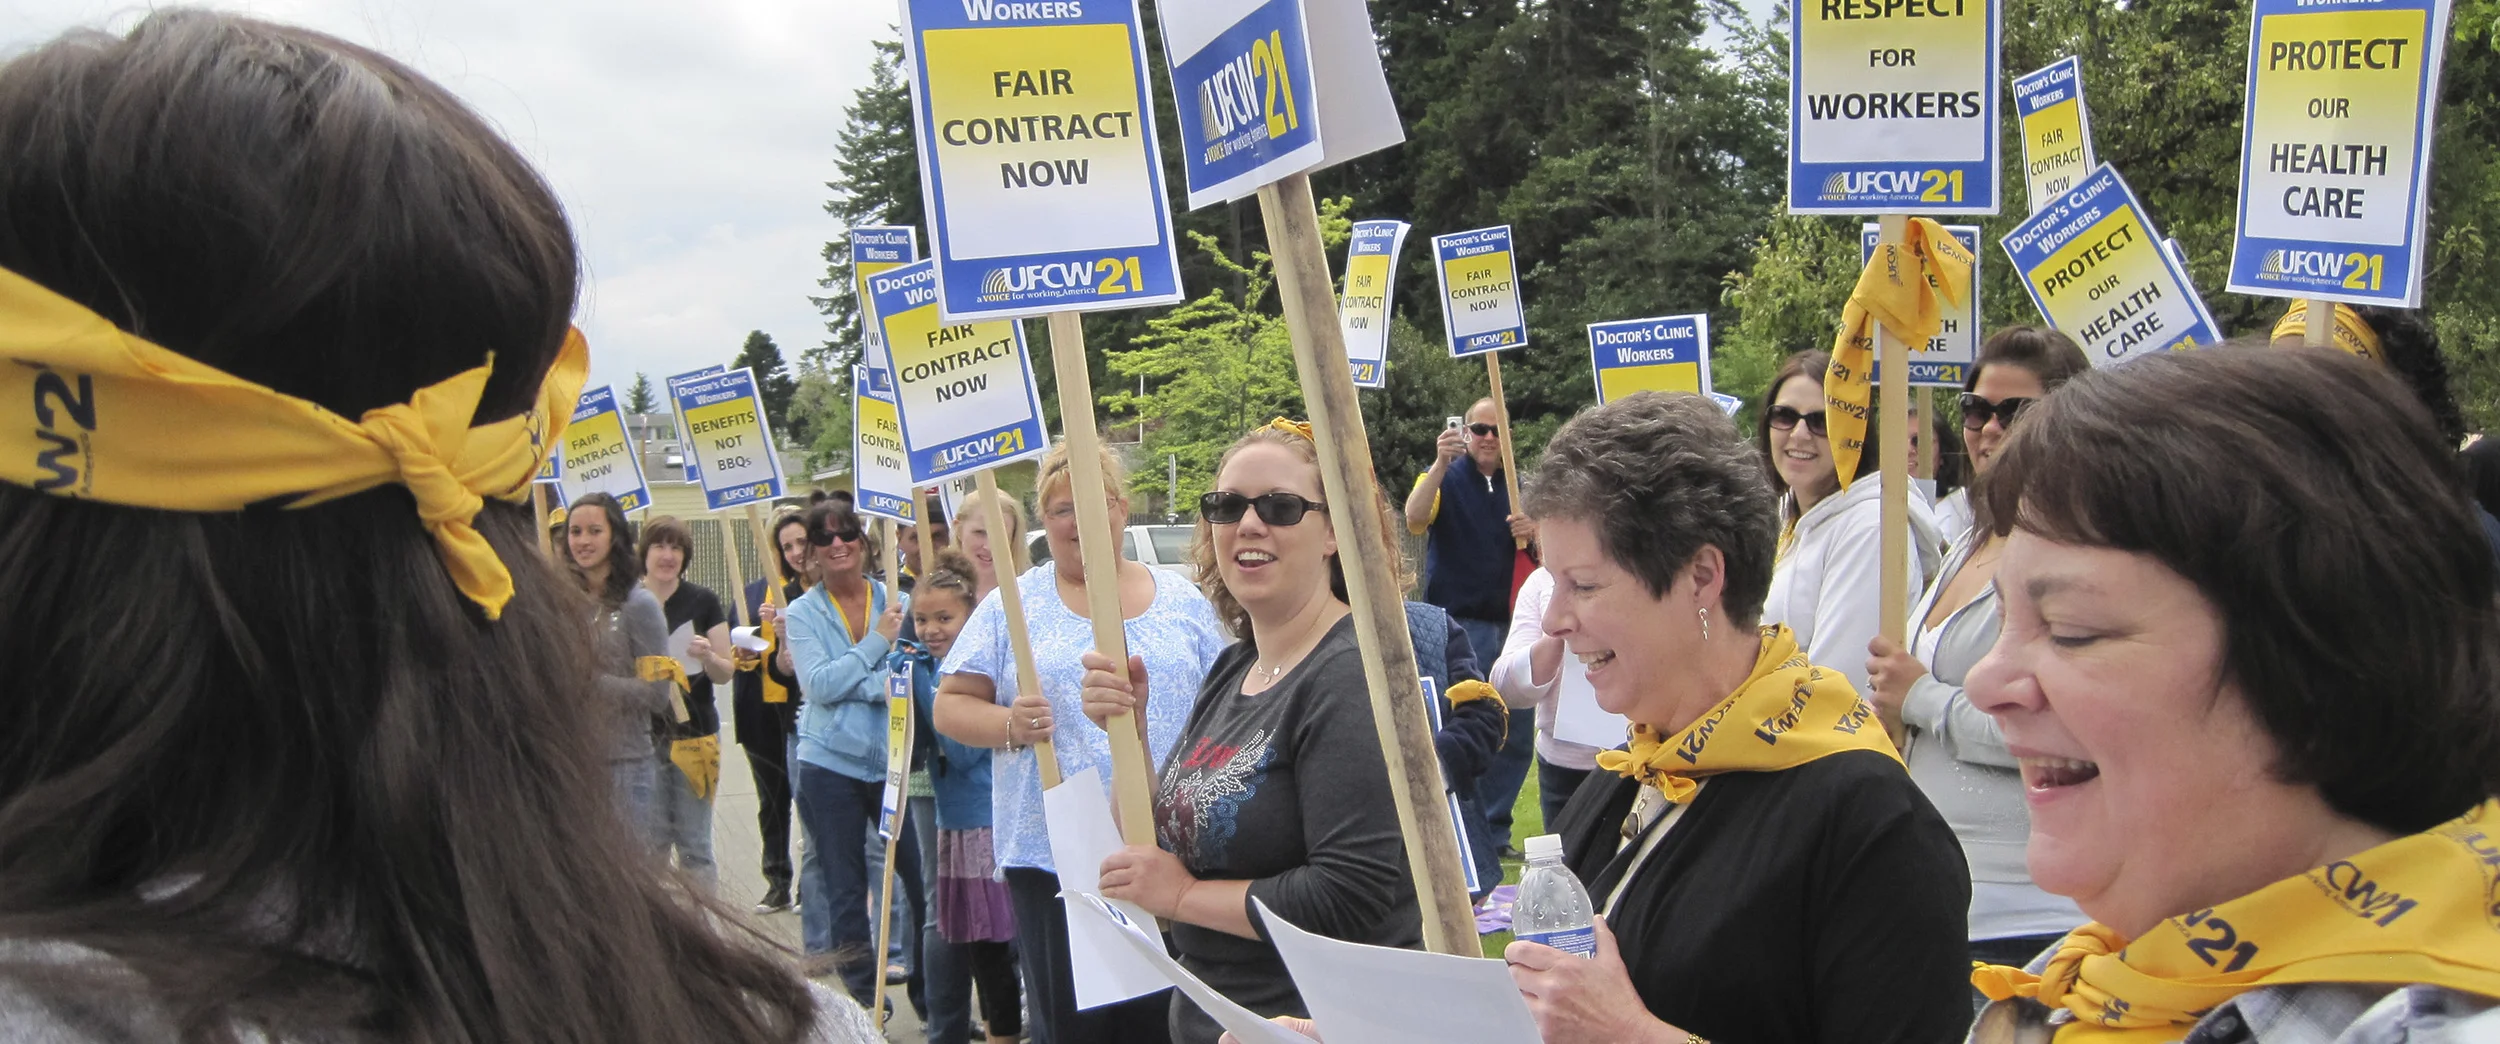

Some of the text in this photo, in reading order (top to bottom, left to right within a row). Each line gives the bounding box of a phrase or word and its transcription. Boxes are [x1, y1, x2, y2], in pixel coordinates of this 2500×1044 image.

[962, 0, 1083, 21] WORKERS
[1821, 0, 1965, 20] RESPECT
[1869, 48, 1916, 67] FOR
[2269, 38, 2408, 71] PROTECT
[993, 69, 1074, 97] FAIR
[2049, 67, 2073, 84] CLINIC
[1807, 91, 1981, 120] WORKERS
[2030, 89, 2064, 110] WORKERS
[2307, 98, 2350, 119] OUR
[942, 112, 1133, 146] CONTRACT
[2041, 128, 2064, 148] FAIR
[2030, 146, 2081, 176] CONTRACT
[2269, 143, 2388, 176] HEALTH
[1001, 159, 1089, 189] NOW
[2046, 176, 2070, 196] NOW
[2069, 174, 2113, 209] CLINIC
[2282, 185, 2365, 219] CARE
[1480, 231, 1507, 241] CLINIC
[2037, 206, 2101, 255] WORKERS
[1456, 244, 1495, 256] WORKERS
[2043, 223, 2134, 297] PROTECT
[876, 269, 935, 294] DOCTOR
[1355, 275, 1372, 288] FAIR
[1466, 269, 1492, 282] FAIR
[983, 294, 1010, 302] VOICE
[1012, 292, 1025, 300] for
[1062, 287, 1097, 296] America
[1451, 281, 1511, 299] CONTRACT
[2088, 274, 2121, 301] OUR
[1345, 296, 1383, 309] CONTRACT
[1470, 299, 1498, 313] NOW
[1349, 317, 1369, 329] NOW
[2080, 281, 2162, 346] HEALTH
[927, 324, 975, 348] FAIR
[1653, 325, 1694, 341] CLINIC
[2105, 311, 2164, 359] CARE
[901, 338, 1012, 384] CONTRACT
[1617, 348, 1674, 364] WORKERS
[935, 373, 988, 403] NOW
[692, 411, 756, 435] BENEFITS
[877, 418, 898, 433] FAIR
[571, 433, 600, 451] FAIR
[715, 435, 743, 451] NOT
[861, 433, 905, 454] CONTRA
[566, 442, 625, 470] ONTRACT
[877, 455, 901, 471] NOW
[580, 464, 613, 483] NOW
